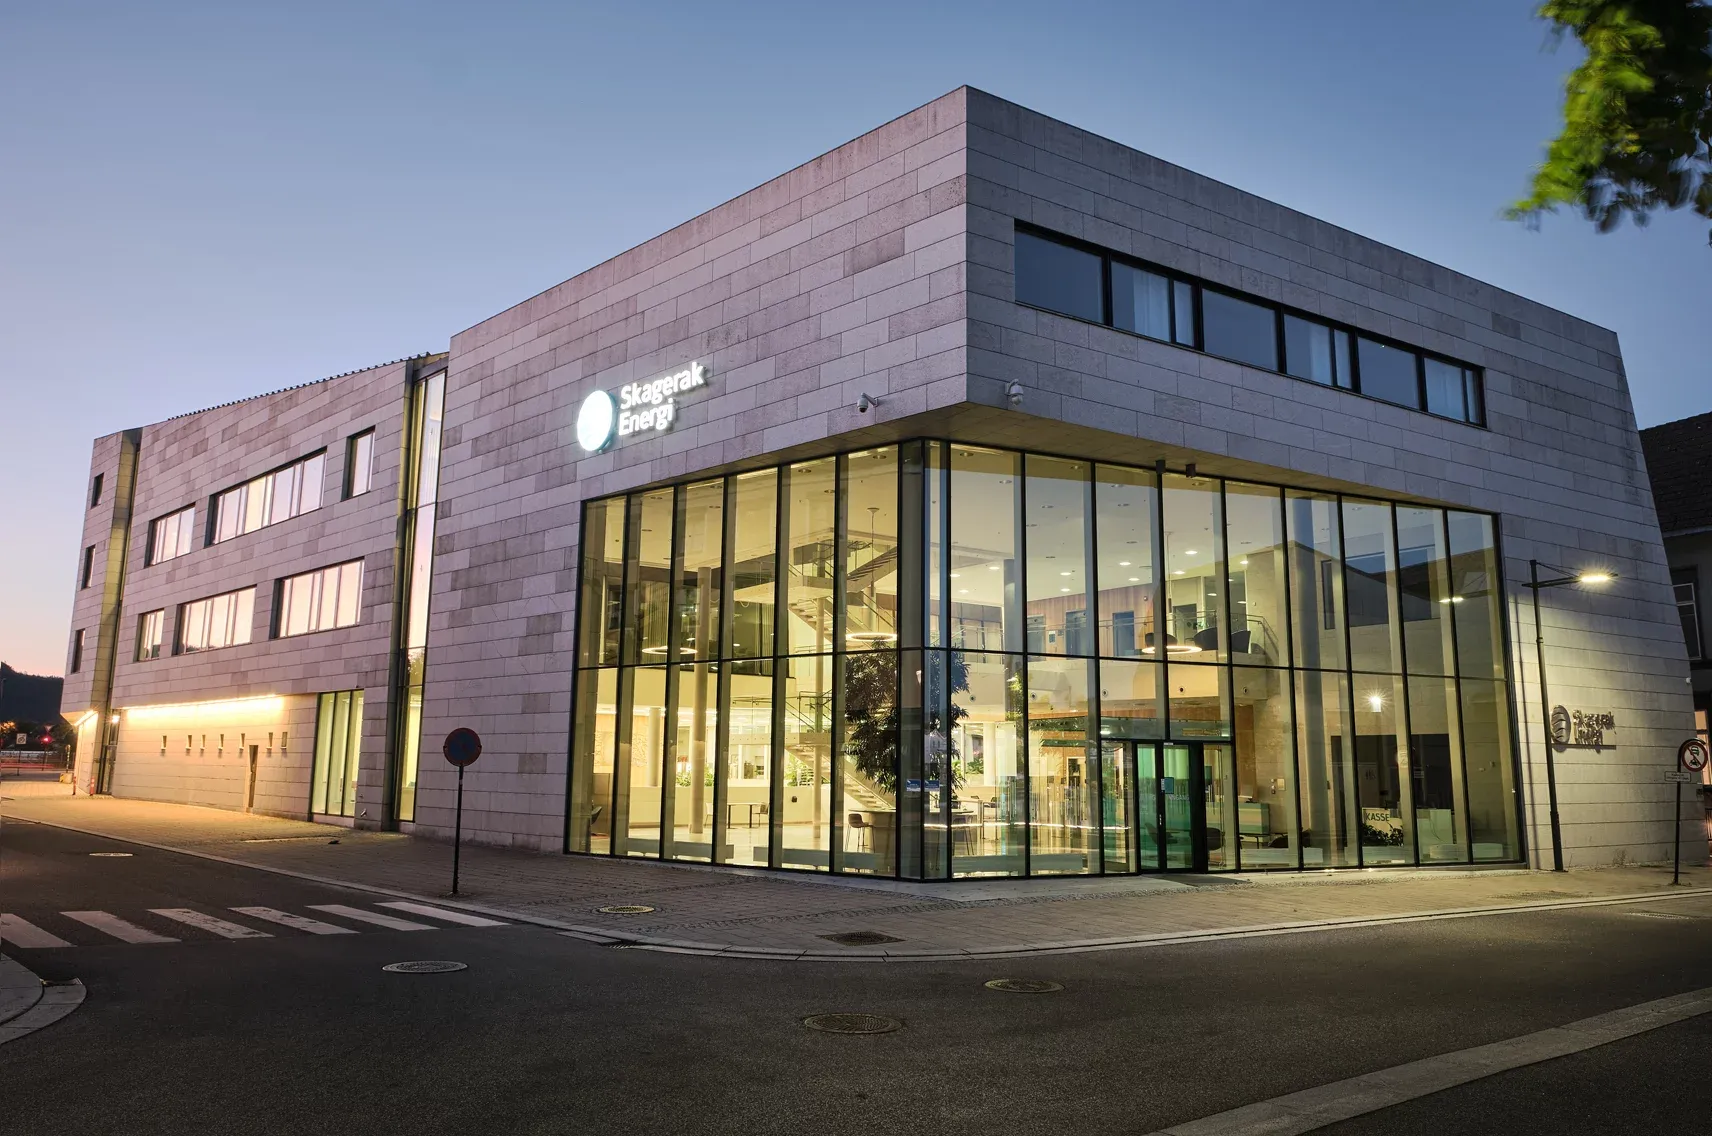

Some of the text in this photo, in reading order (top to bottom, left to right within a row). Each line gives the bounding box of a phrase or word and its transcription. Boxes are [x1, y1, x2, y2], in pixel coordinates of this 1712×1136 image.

[620, 361, 704, 410] Skagerak
[618, 398, 675, 436] Energi
[1365, 812, 1390, 822] KASSE
